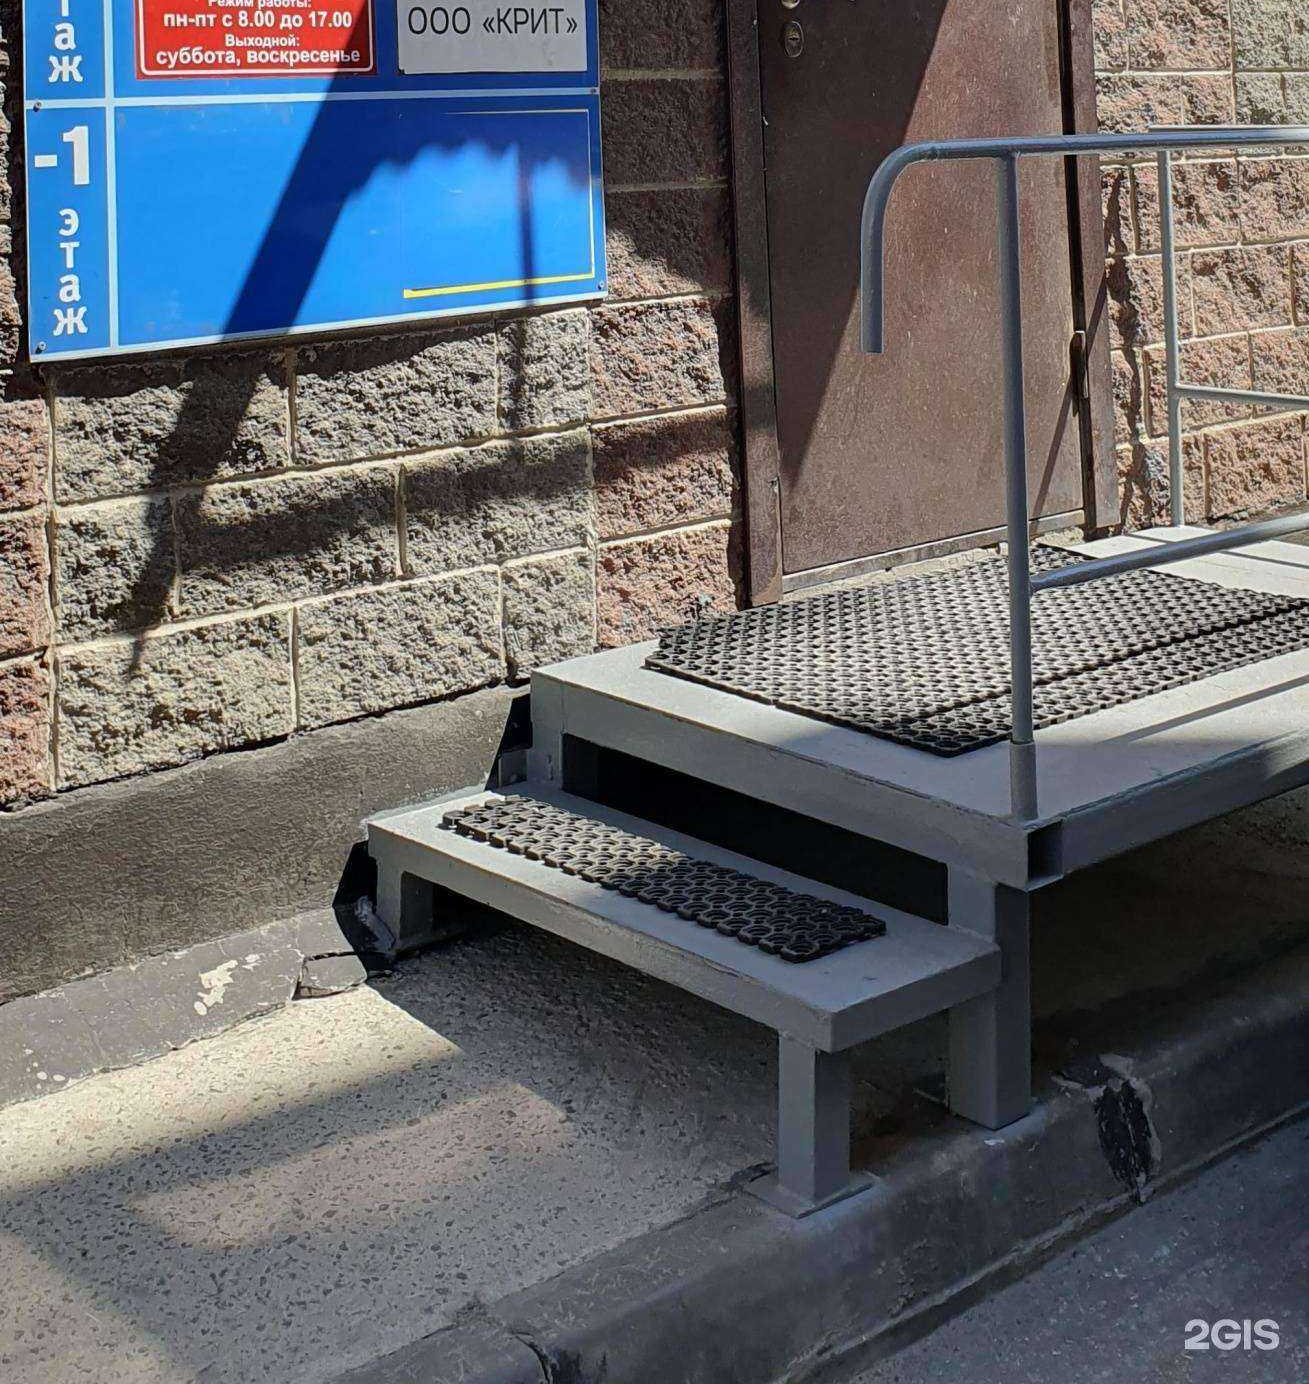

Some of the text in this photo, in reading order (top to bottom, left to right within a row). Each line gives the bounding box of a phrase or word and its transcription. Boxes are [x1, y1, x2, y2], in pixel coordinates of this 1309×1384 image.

[163, 11, 352, 30] пн-пт с 8.00 до 17.00
[408, 6, 578, 35] ООО «КРИТ»
[225, 33, 300, 49] Выходной:
[156, 48, 361, 69] суббота, воскресенье
[34, 125, 91, 186] -1
[52, 208, 89, 337] этаж
